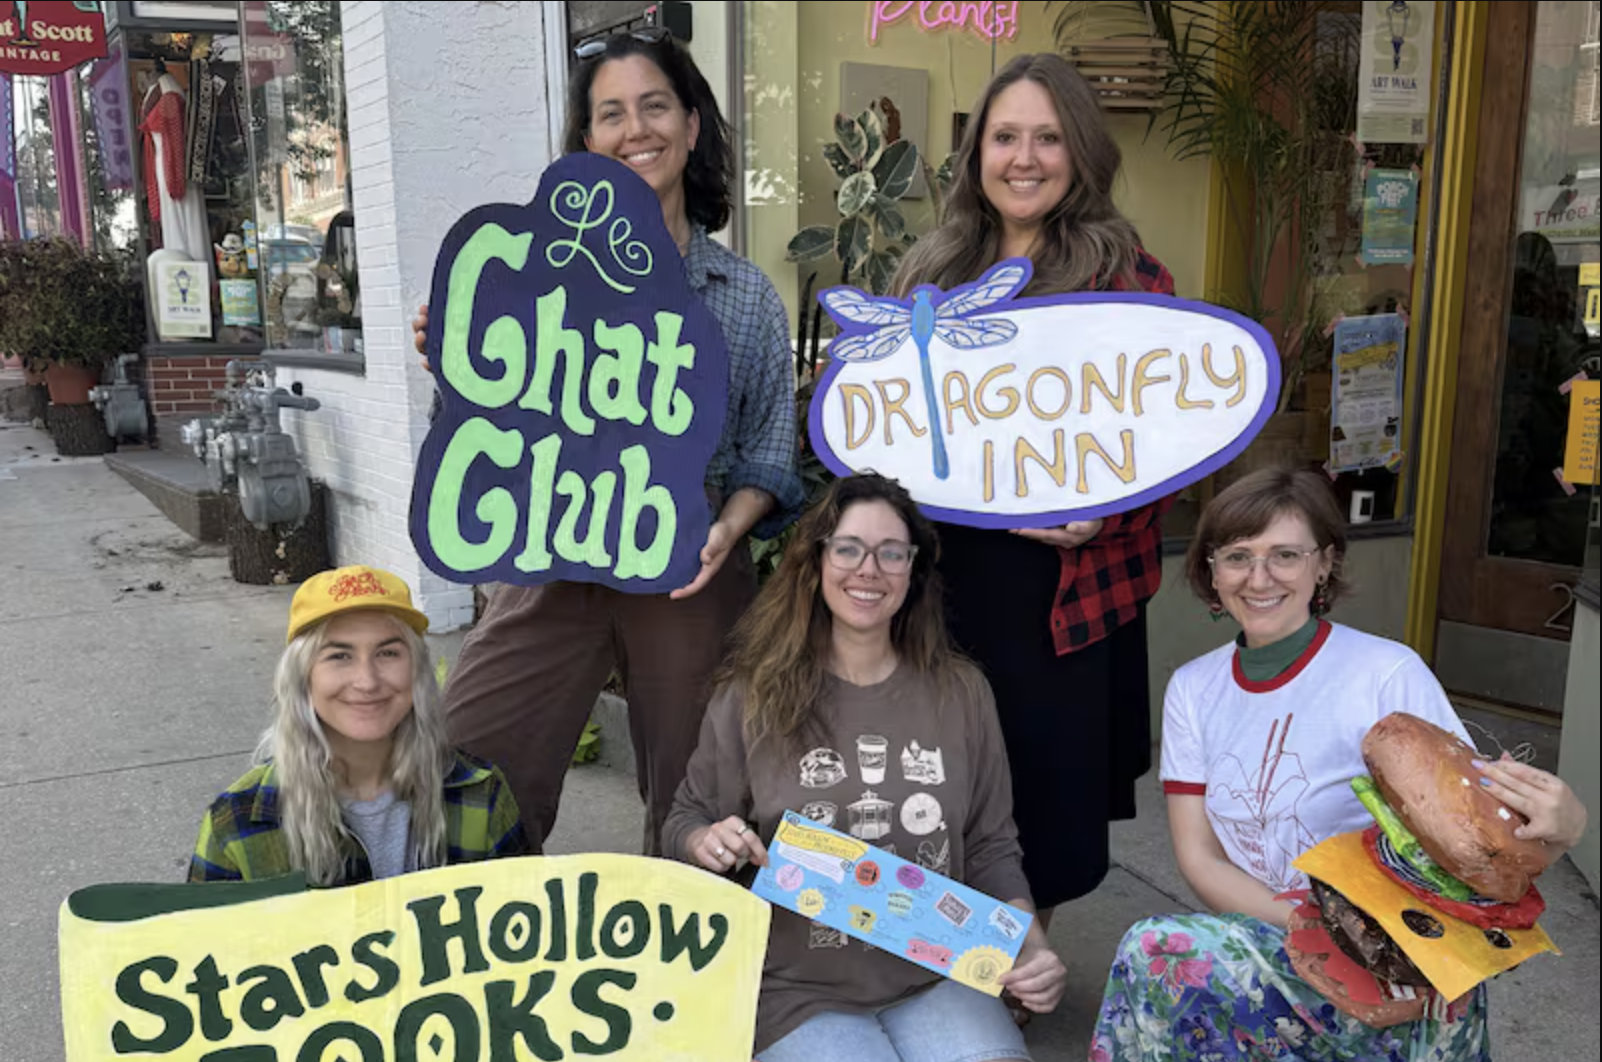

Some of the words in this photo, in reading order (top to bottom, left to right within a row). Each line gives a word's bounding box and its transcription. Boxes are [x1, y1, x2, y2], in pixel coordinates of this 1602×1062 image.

[31, 20, 95, 43] Scott
[545, 179, 653, 293] Le
[1534, 206, 1588, 227] Three
[441, 222, 696, 435] Chat
[839, 342, 1247, 450] DRAGONFLY
[427, 416, 677, 580] Club
[983, 428, 1137, 503] INN
[1544, 582, 1573, 631] 2
[111, 929, 400, 1054] Stars
[406, 872, 729, 987] Hollow
[198, 968, 637, 1061] OKS
